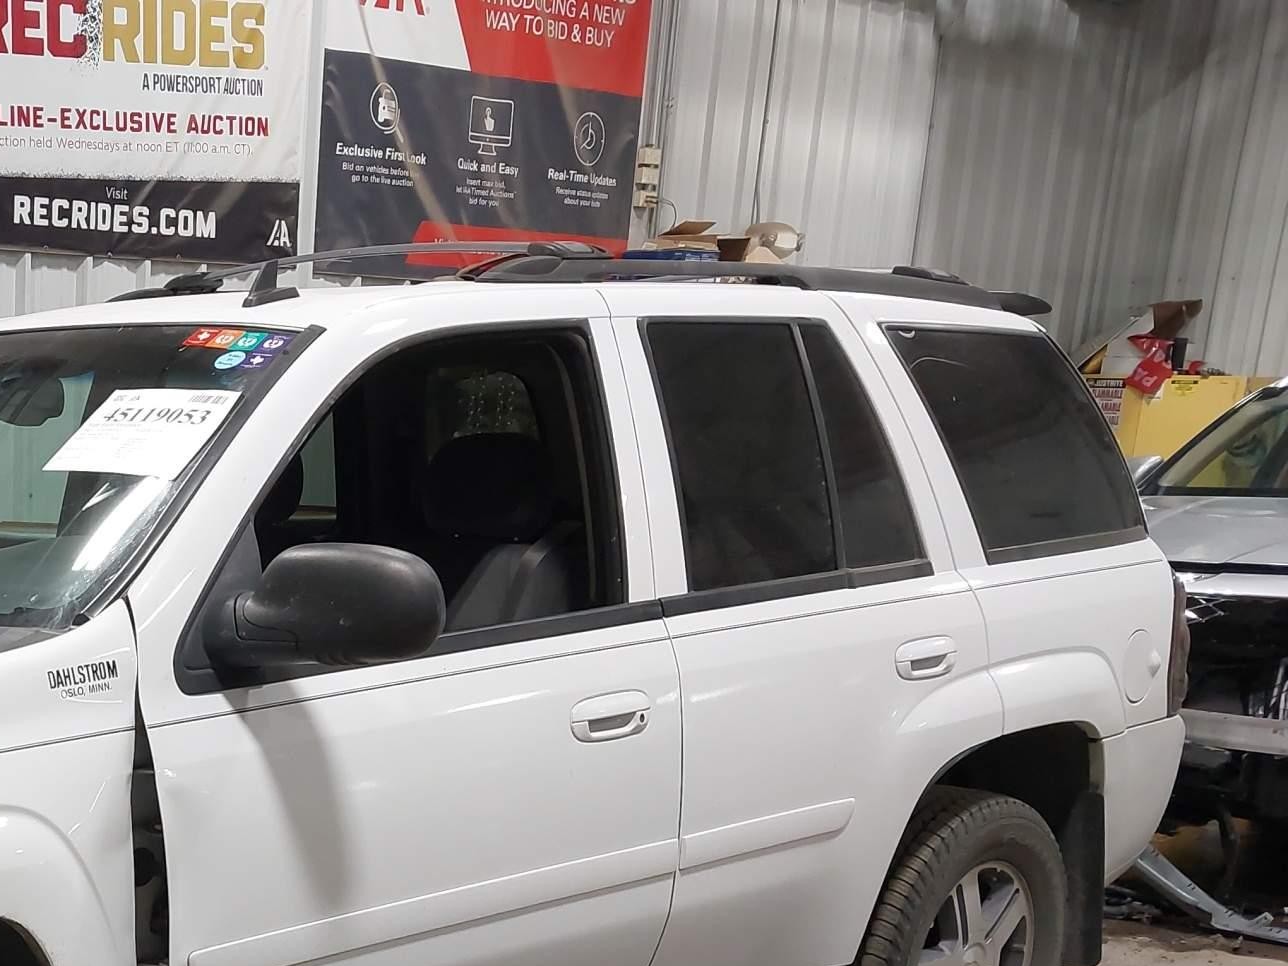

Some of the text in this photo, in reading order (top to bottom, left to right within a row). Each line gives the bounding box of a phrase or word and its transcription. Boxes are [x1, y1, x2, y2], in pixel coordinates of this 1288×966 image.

[580, 3, 589, 20] A
[593, 4, 625, 26] NEW
[102, 0, 265, 70] RIDES
[486, 9, 614, 47] WAY TO BID & BUY
[142, 73, 263, 96] A POWERSPORT AUCTION
[187, 114, 269, 137] AUCTION
[29, 136, 53, 149] held
[56, 137, 120, 153] Wednesdays
[122, 142, 132, 151] at
[136, 143, 162, 152] noon
[165, 142, 179, 153] ET
[211, 145, 231, 154] a.m.
[335, 142, 383, 159] Exclusive
[342, 162, 354, 171] Bid
[366, 165, 389, 175] vehicles
[390, 167, 409, 177] before
[457, 157, 519, 178] Quick and Easy
[547, 167, 617, 187] Real-Time Updates
[351, 174, 414, 187] go to the live auction
[106, 187, 129, 200] Visit
[13, 195, 217, 239] RECRIDES.COM
[103, 407, 212, 425] 45119053
[47, 659, 119, 689] DAHLSTROM
[60, 682, 112, 699] OSLO, MINN.
